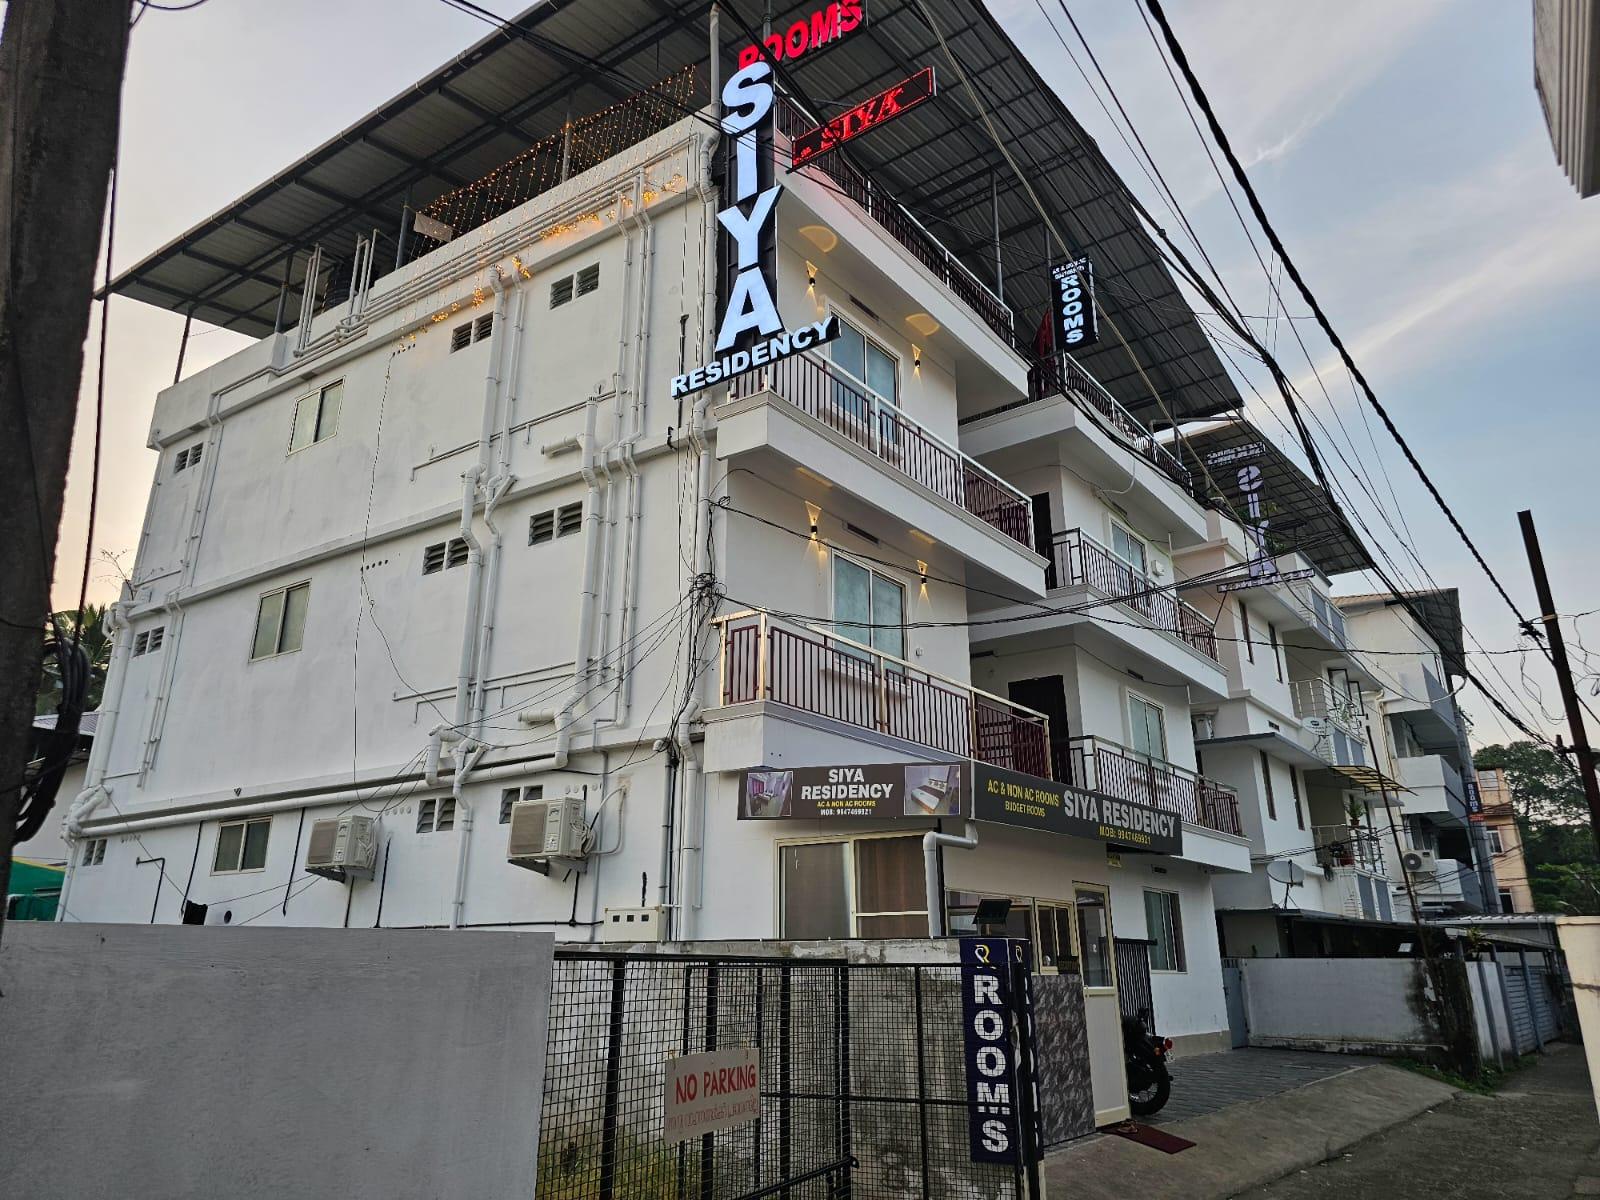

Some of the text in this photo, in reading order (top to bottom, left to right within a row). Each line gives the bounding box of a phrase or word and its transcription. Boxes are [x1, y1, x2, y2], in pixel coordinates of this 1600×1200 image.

[714, 61, 785, 353] SIYA
[1060, 273, 1084, 344] ROOMS
[670, 316, 837, 398] RESIDENCY
[801, 783, 894, 800] RESIDENCY
[828, 767, 865, 784] SIYA
[987, 779, 1060, 808] AC & NON AC ROOMS
[1005, 800, 1046, 817] BUDGET ROOMS
[1063, 790, 1176, 838] SIYA RESIDENCY
[675, 1063, 756, 1105] NO PARKING
[973, 974, 1011, 1153] ROOMS
